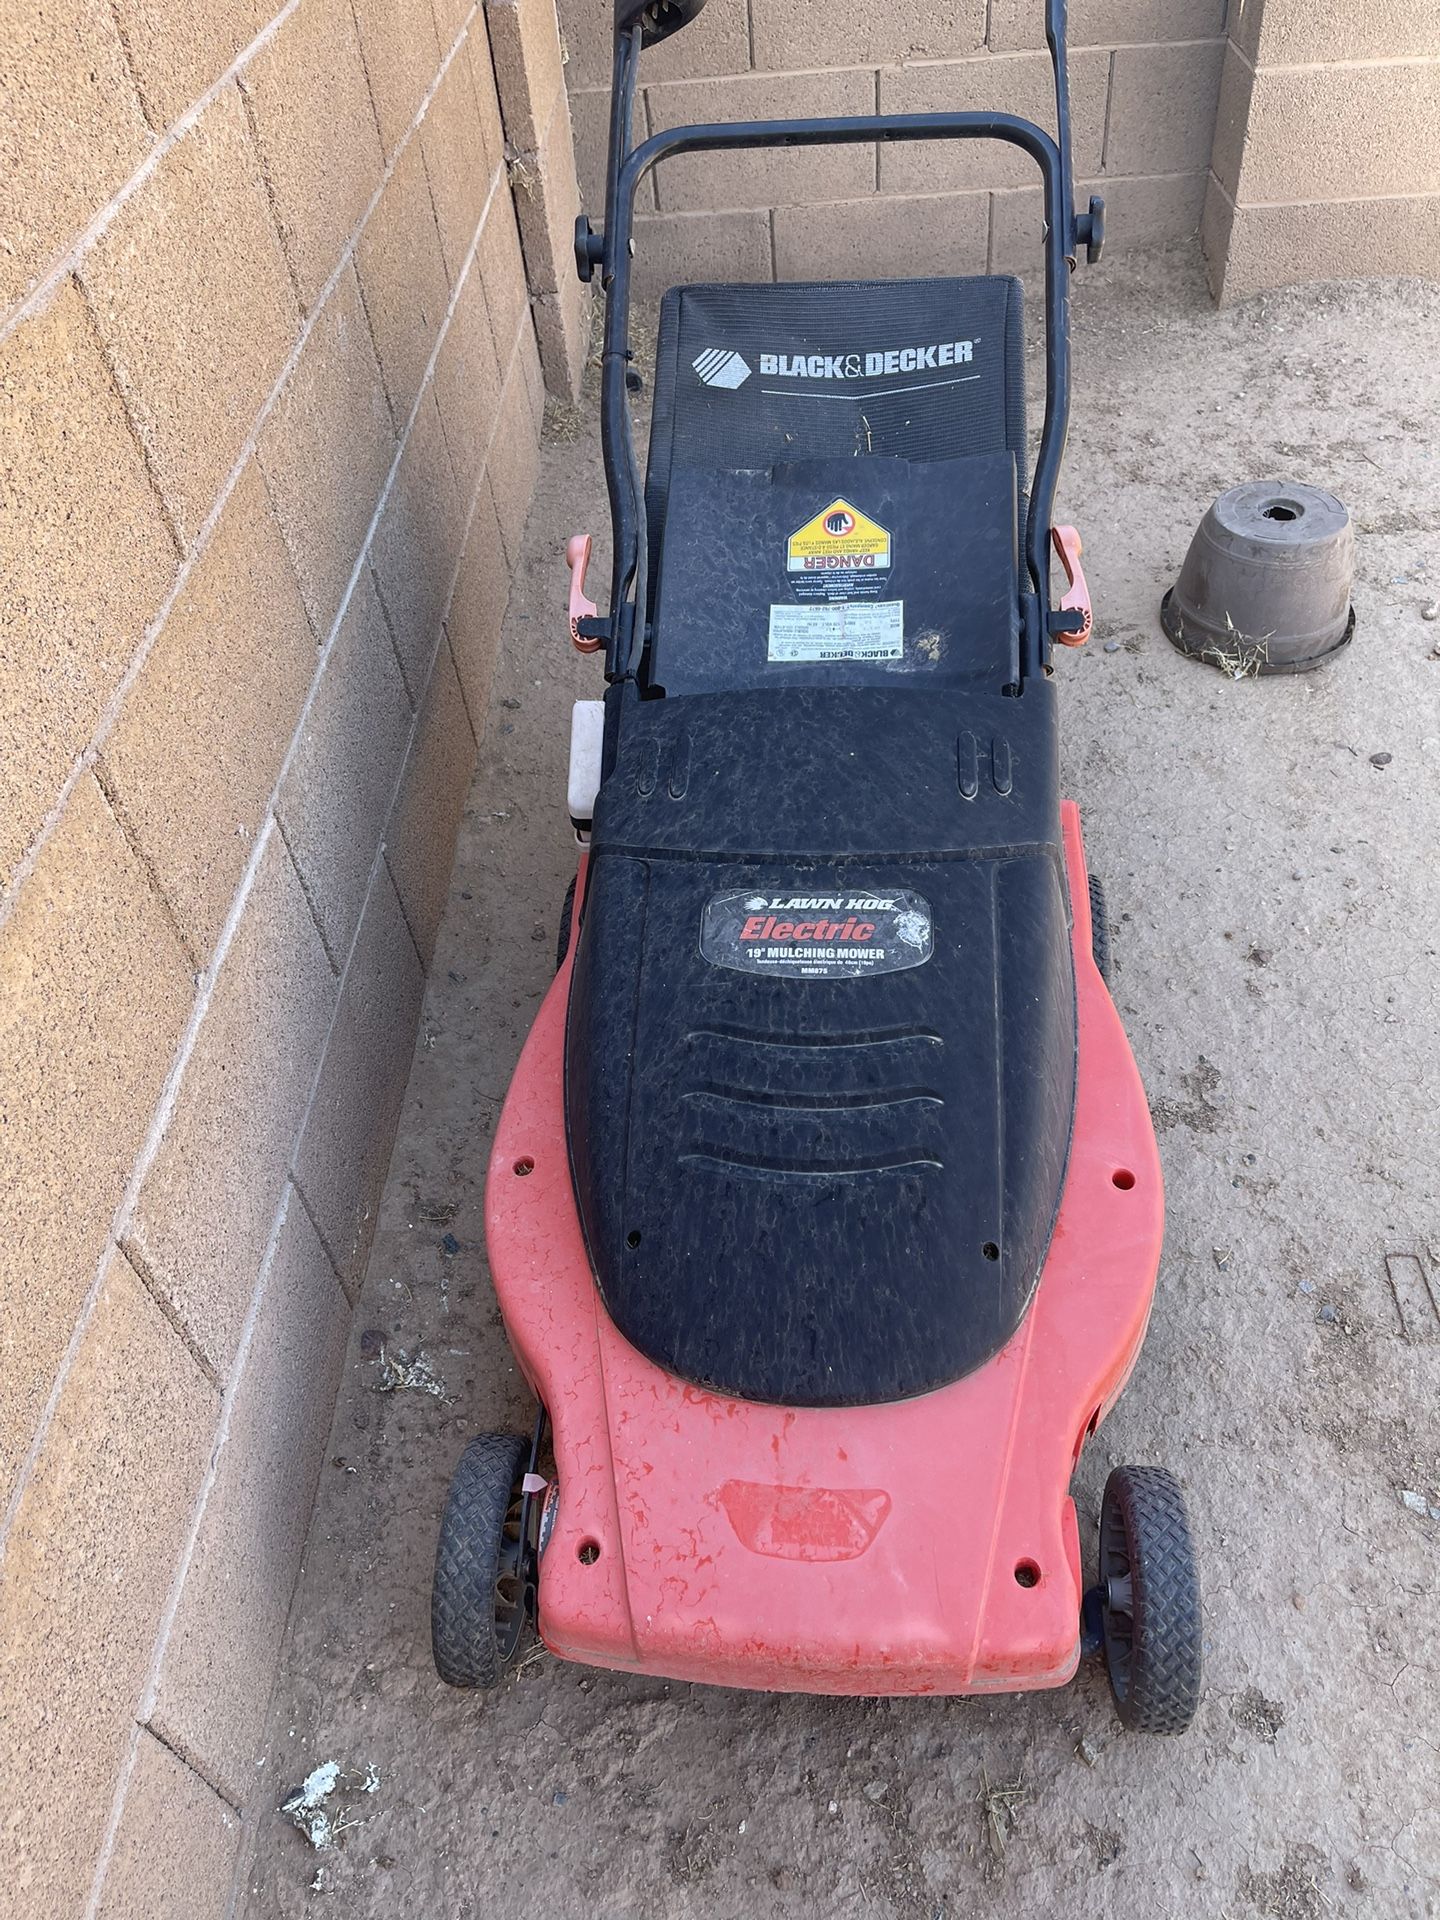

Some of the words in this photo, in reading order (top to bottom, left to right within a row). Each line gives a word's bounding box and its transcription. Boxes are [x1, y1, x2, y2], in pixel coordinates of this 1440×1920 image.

[759, 339, 973, 378] BLACK&DECKER
[804, 555, 874, 569] DANGER
[820, 649, 889, 658] BLACK&DECKER
[768, 898, 843, 910] LAWN
[846, 898, 895, 910] HOG
[739, 916, 876, 941] Electric
[746, 947, 766, 958] 19"
[767, 947, 836, 958] MULCHING
[837, 948, 885, 959] MOWER
